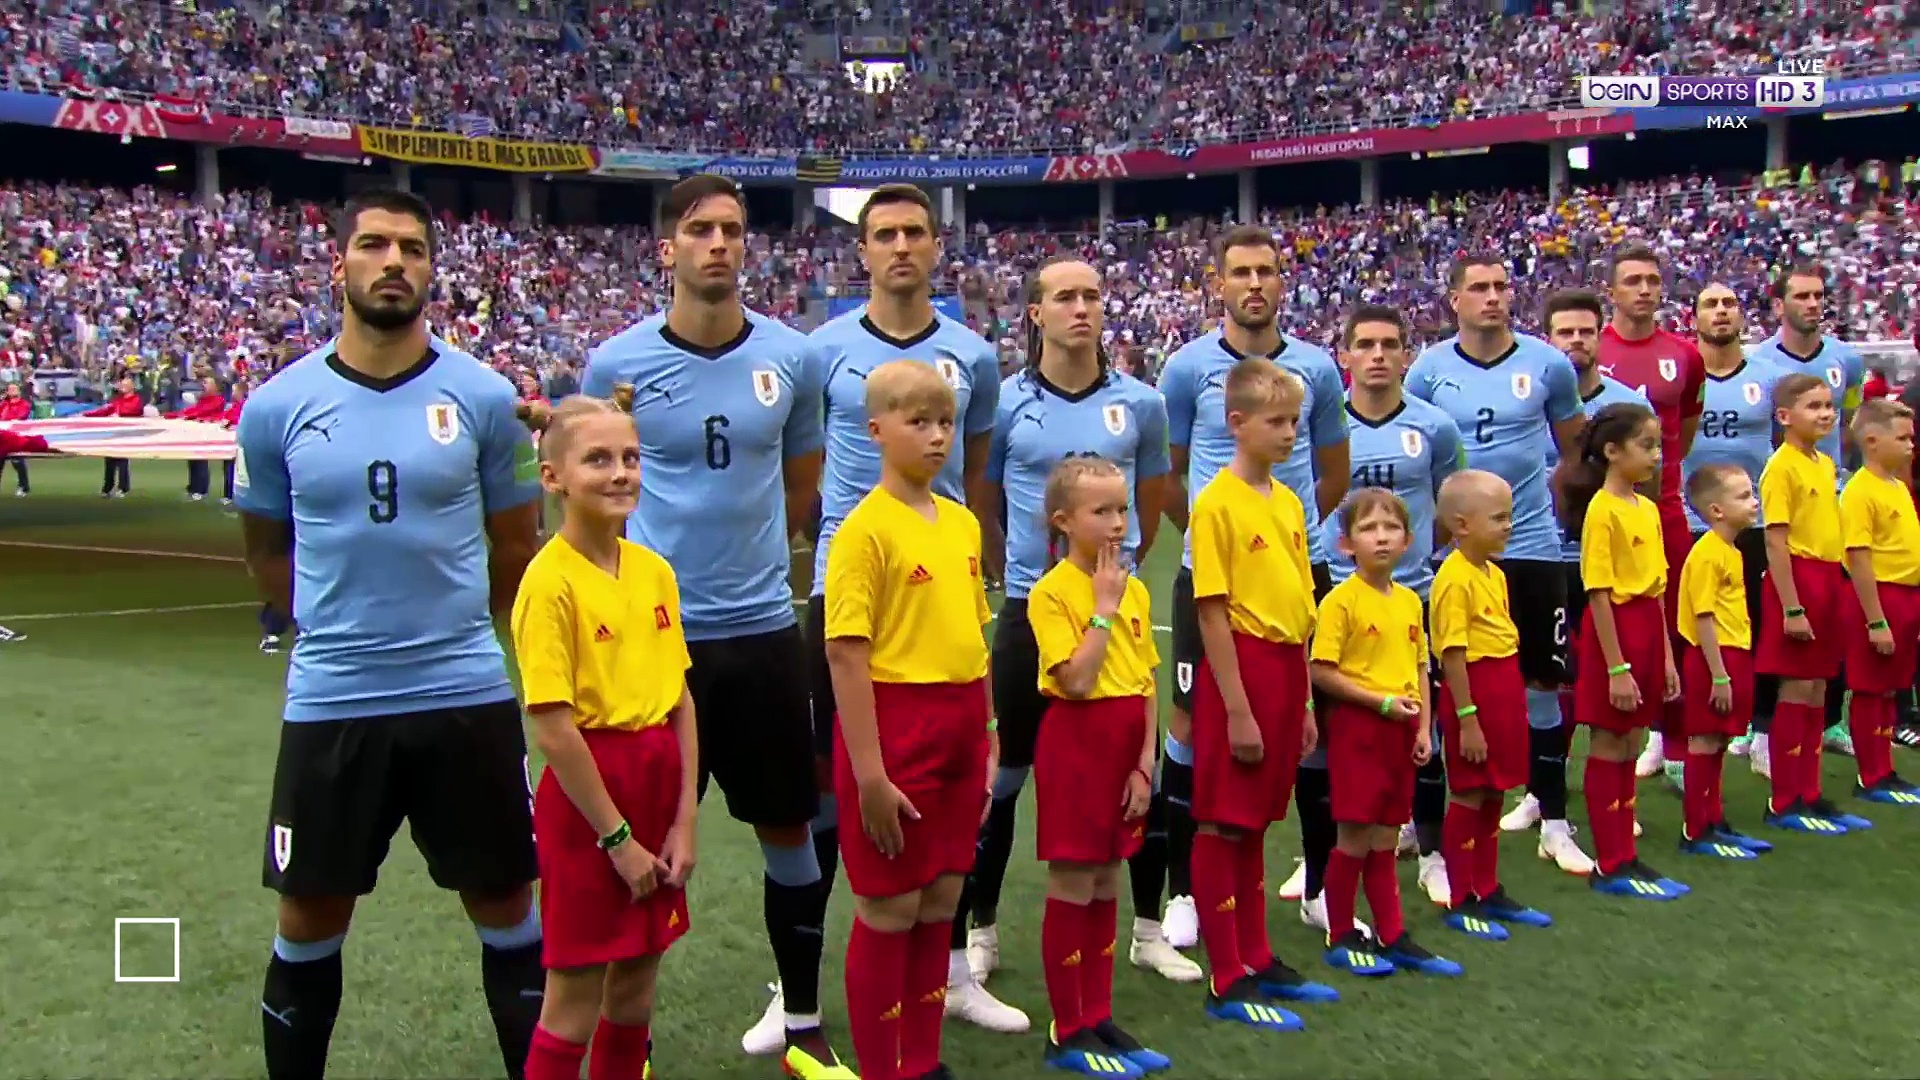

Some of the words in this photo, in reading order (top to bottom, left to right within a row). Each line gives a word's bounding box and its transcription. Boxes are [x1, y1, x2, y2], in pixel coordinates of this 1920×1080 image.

[366, 129, 473, 162] SIMPLEMENTE
[478, 140, 492, 164] EL
[496, 145, 524, 167] MAS
[528, 147, 586, 168] GRANDE
[705, 415, 730, 470] 6
[1476, 407, 1495, 444] 2
[1702, 409, 1739, 438] 22
[367, 460, 398, 524] 9
[1554, 607, 1566, 646] 2
